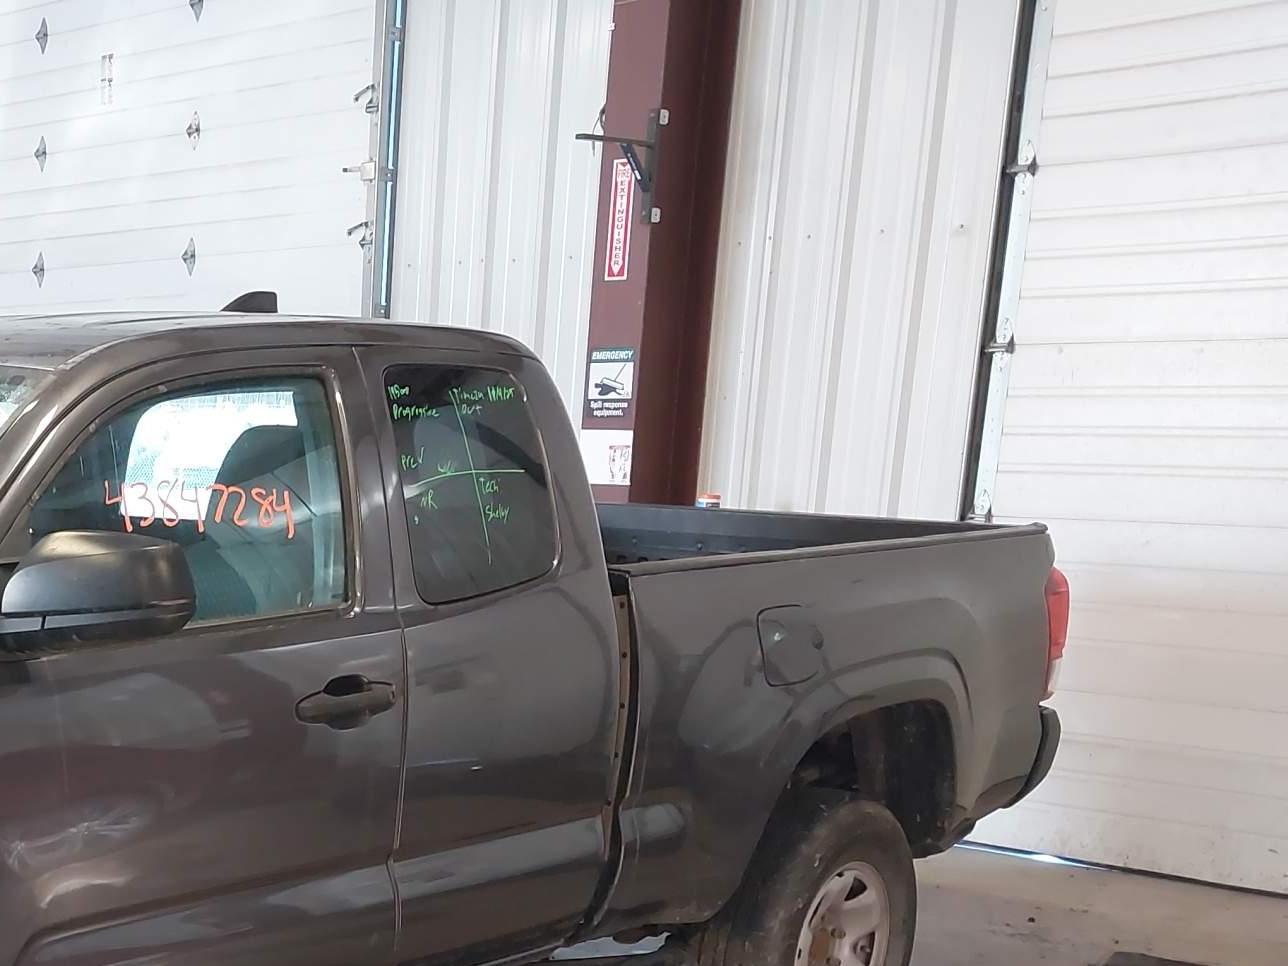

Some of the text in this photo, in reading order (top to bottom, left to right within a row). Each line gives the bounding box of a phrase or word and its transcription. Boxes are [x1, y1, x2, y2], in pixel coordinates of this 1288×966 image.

[613, 180, 626, 266] EXTINGUISHER
[592, 350, 633, 360] EMERGENCY
[590, 401, 603, 409] Spill
[104, 479, 294, 540] 43847284
